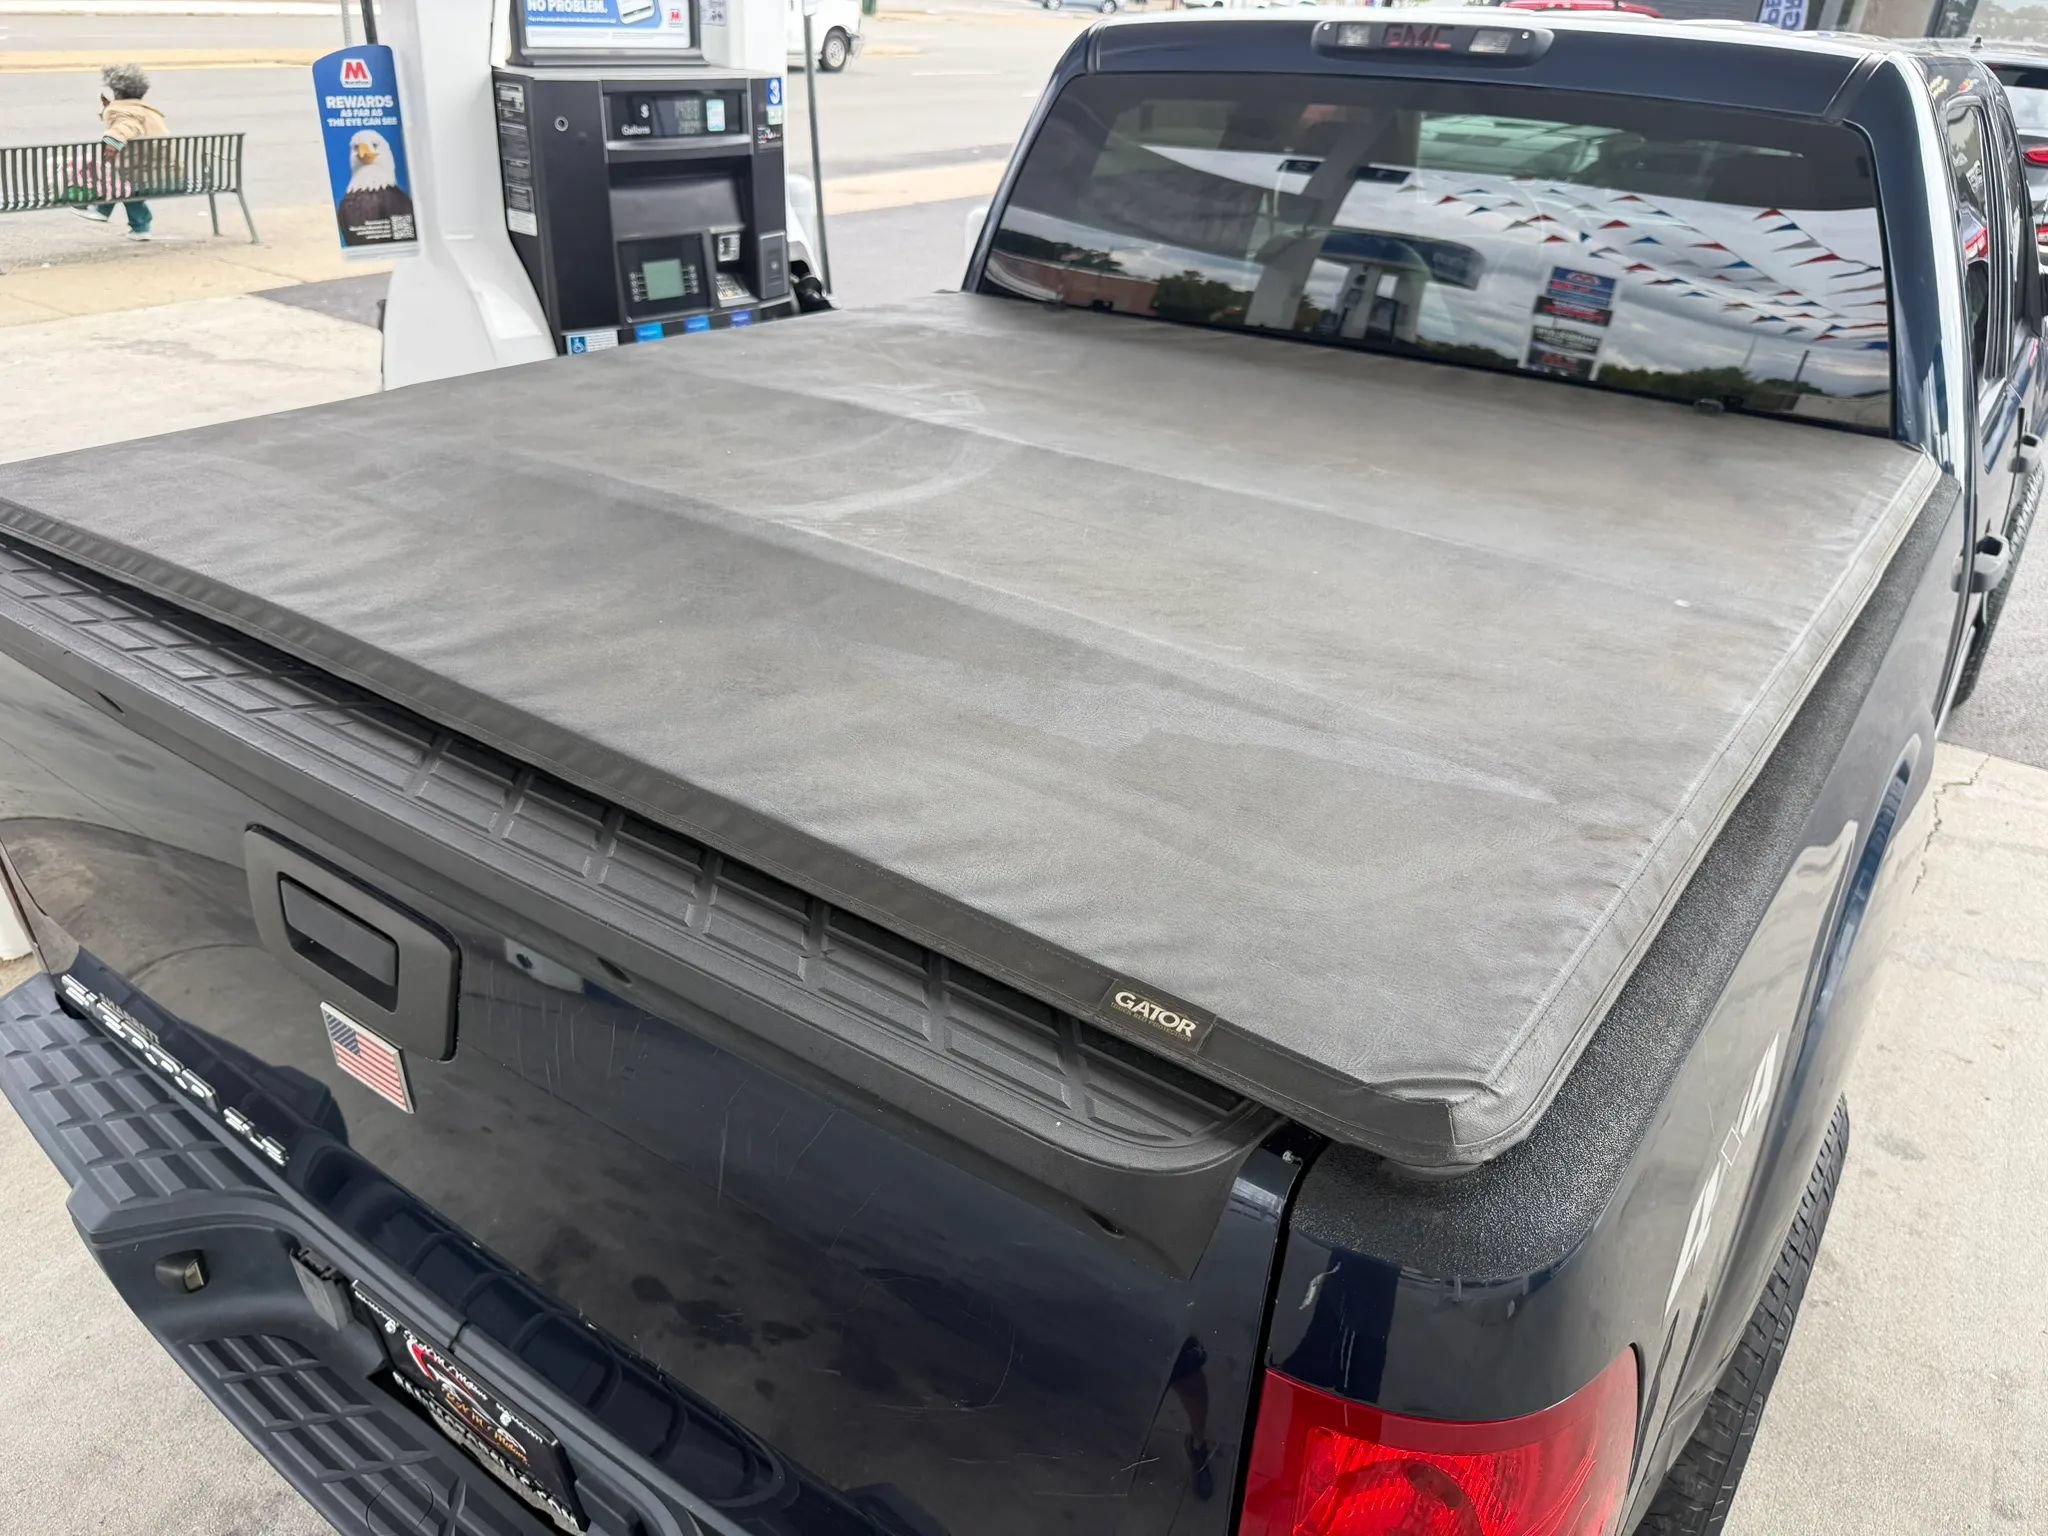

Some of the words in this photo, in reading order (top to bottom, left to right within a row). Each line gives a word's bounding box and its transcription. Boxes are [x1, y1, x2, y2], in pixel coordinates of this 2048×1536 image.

[527, 0, 546, 12] NO
[547, 0, 608, 14] PROBLEM.
[769, 79, 780, 105] 3
[325, 94, 394, 109] REWARDS
[341, 109, 352, 117] AS
[353, 109, 370, 117] FAR
[371, 108, 383, 116] AS
[327, 118, 345, 127] THE
[345, 117, 362, 126] EYE
[362, 116, 381, 126] CAN
[382, 116, 397, 125] SEE
[1115, 991, 1197, 1038] GATOR
